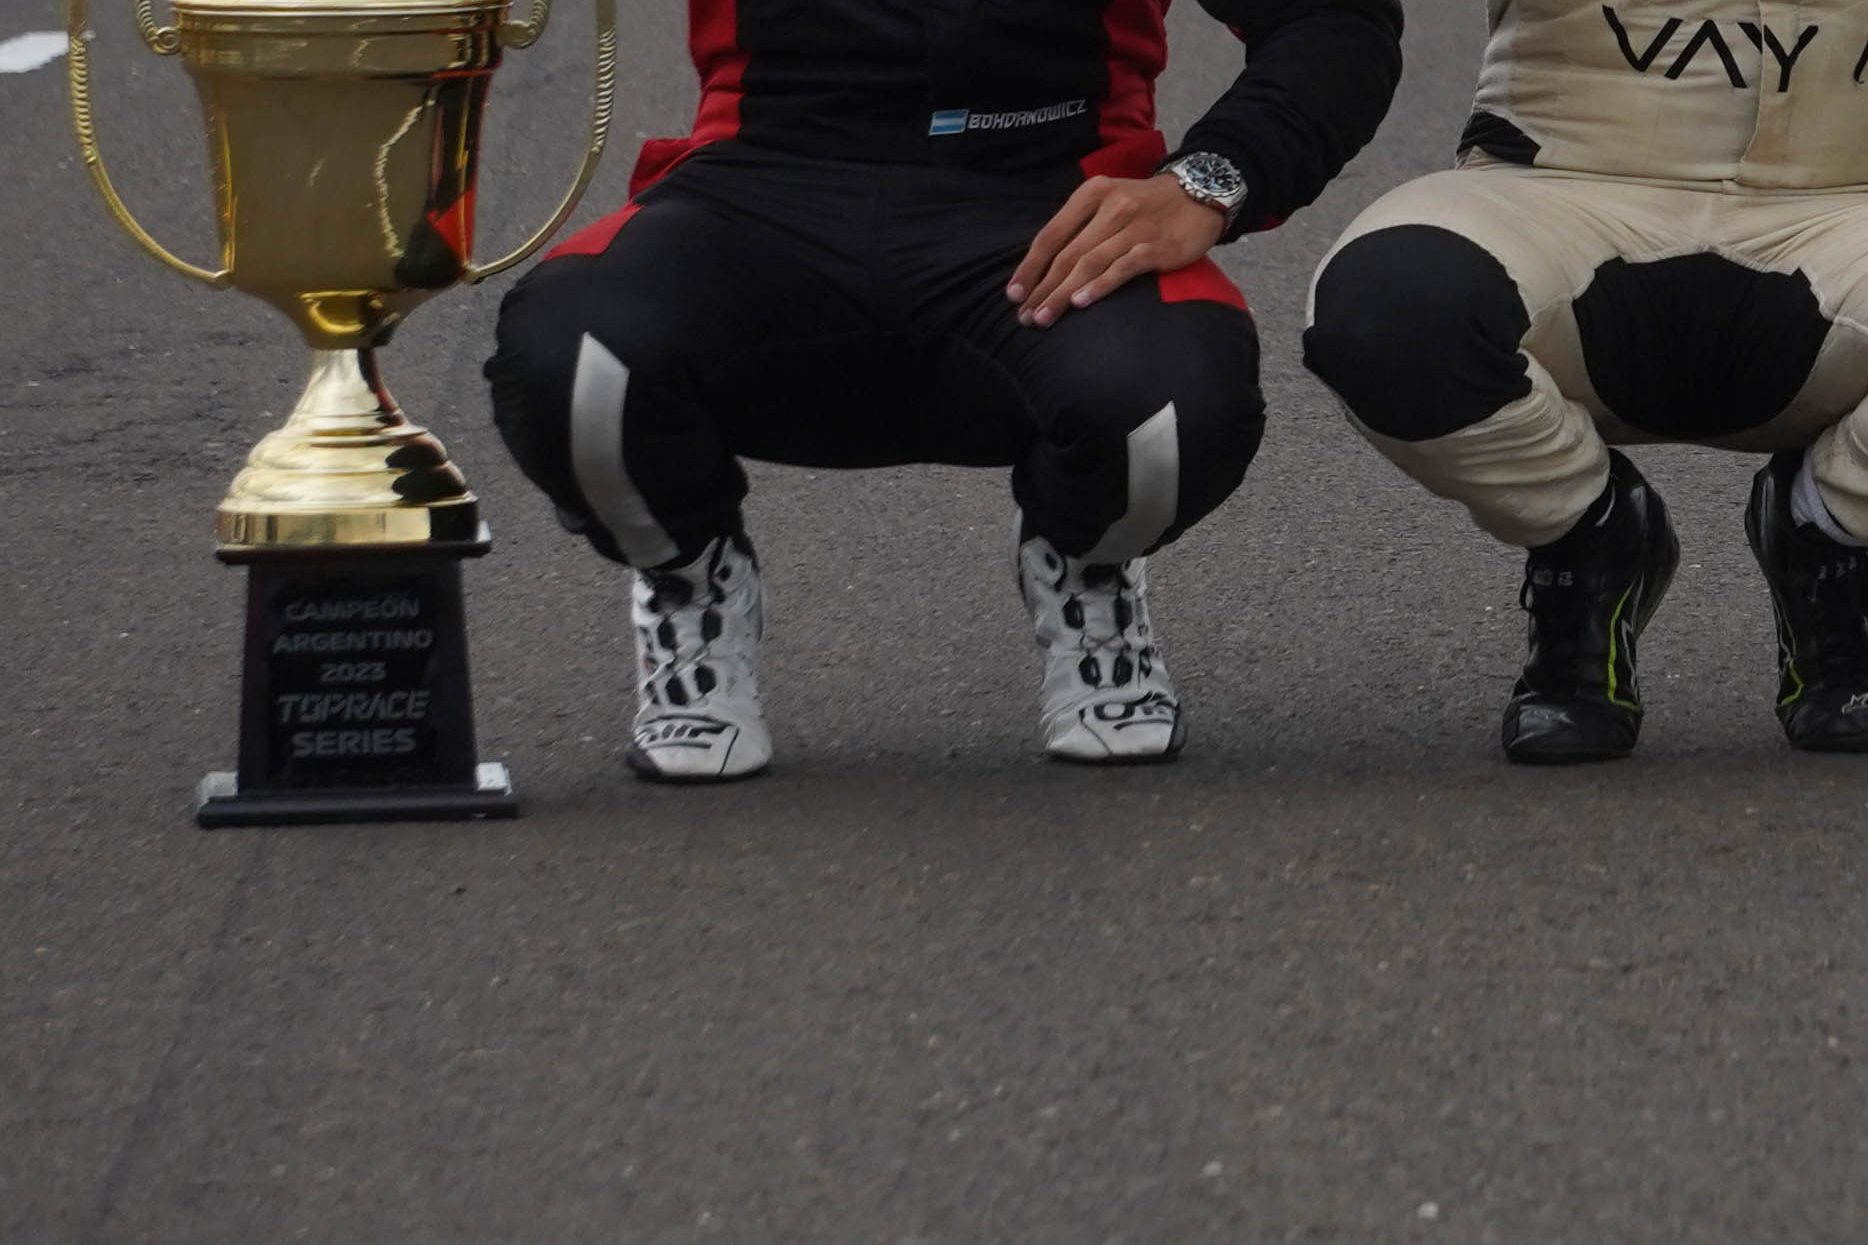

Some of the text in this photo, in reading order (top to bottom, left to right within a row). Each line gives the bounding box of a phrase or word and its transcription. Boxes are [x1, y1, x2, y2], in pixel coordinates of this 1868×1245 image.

[285, 593, 420, 621] CAMPEÓN
[273, 629, 433, 654] ARGENTINO
[320, 661, 386, 683] 2023
[276, 690, 431, 724] TOPRACE
[291, 728, 416, 755] SERIES
